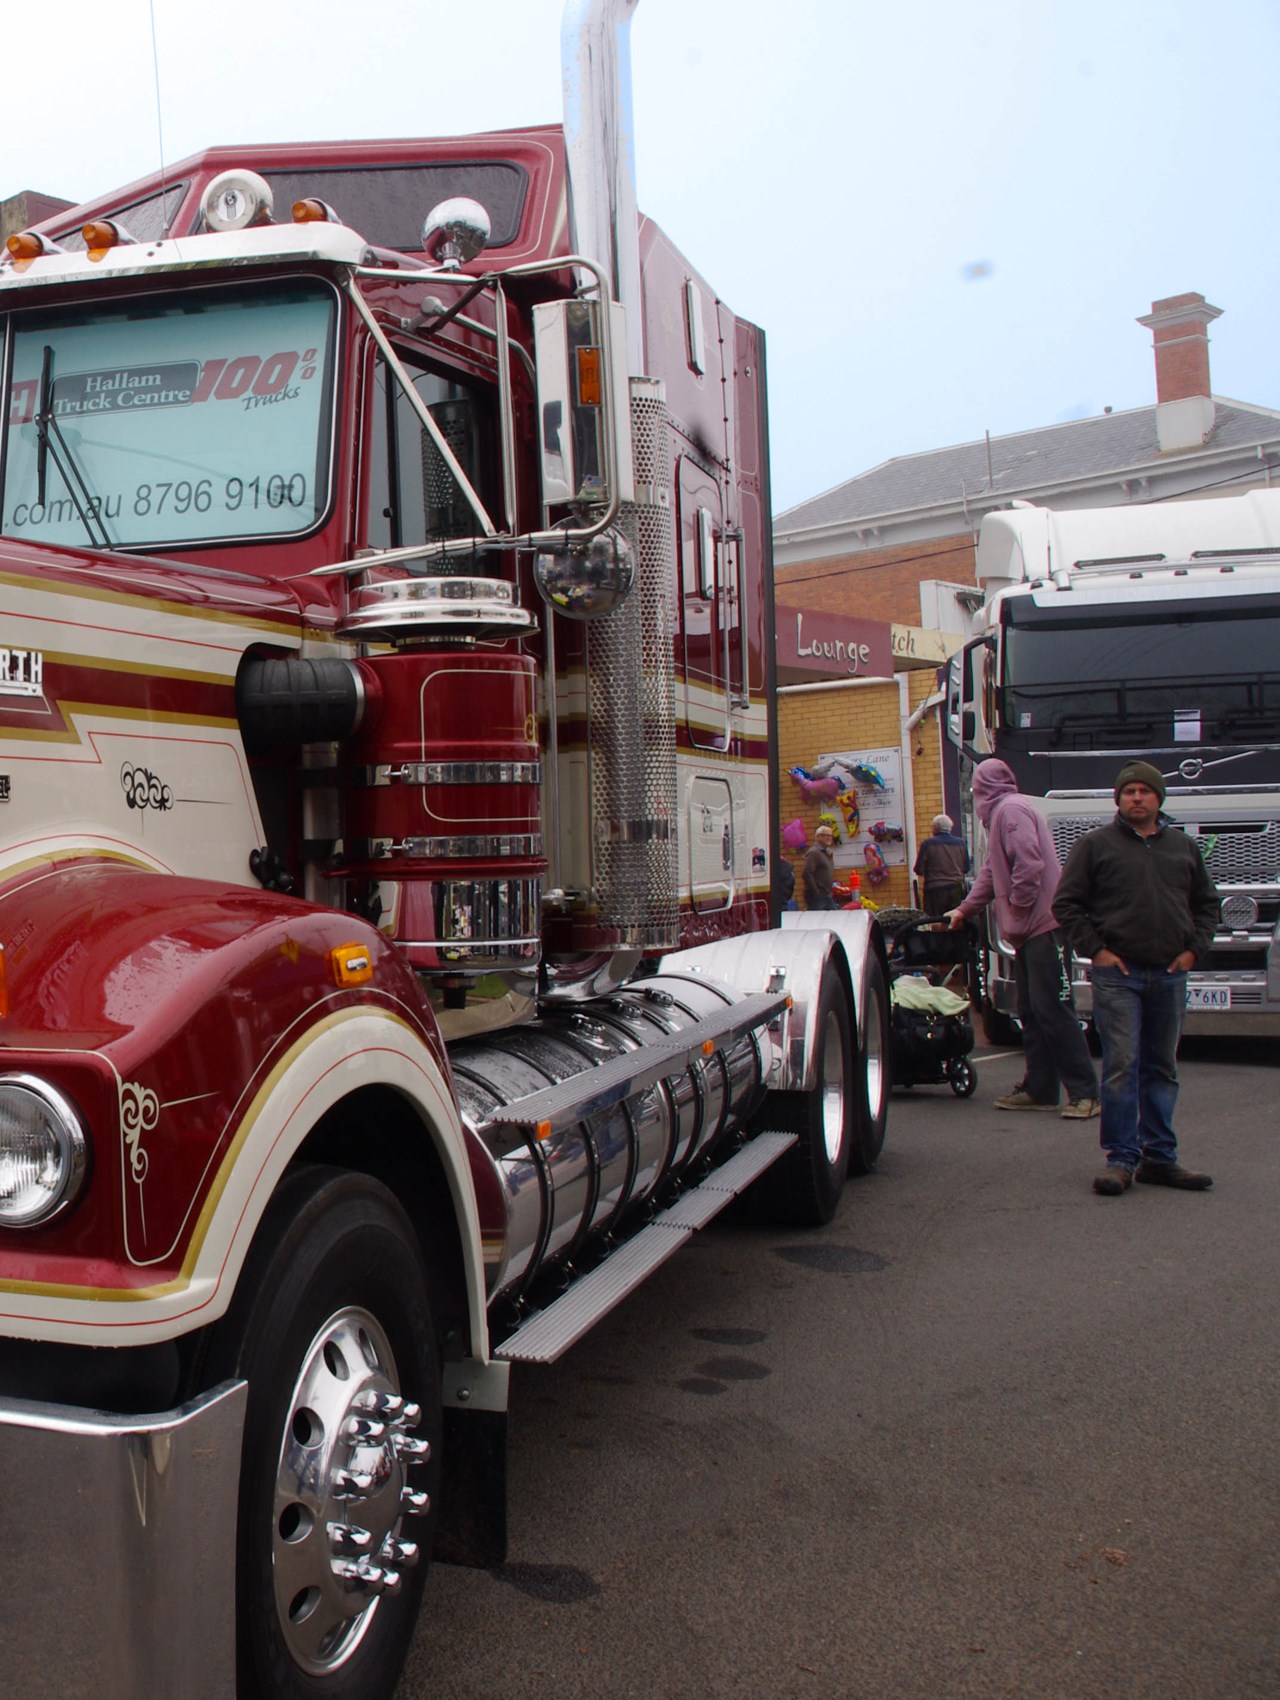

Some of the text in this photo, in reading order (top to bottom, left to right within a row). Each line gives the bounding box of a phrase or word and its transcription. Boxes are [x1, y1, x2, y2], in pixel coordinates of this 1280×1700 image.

[85, 371, 162, 393] Hallam
[54, 389, 191, 415] Truck Centre
[241, 383, 302, 411] Trucks
[133, 479, 213, 516] 8796
[224, 473, 306, 511] 9100
[797, 612, 870, 673] Lounge
